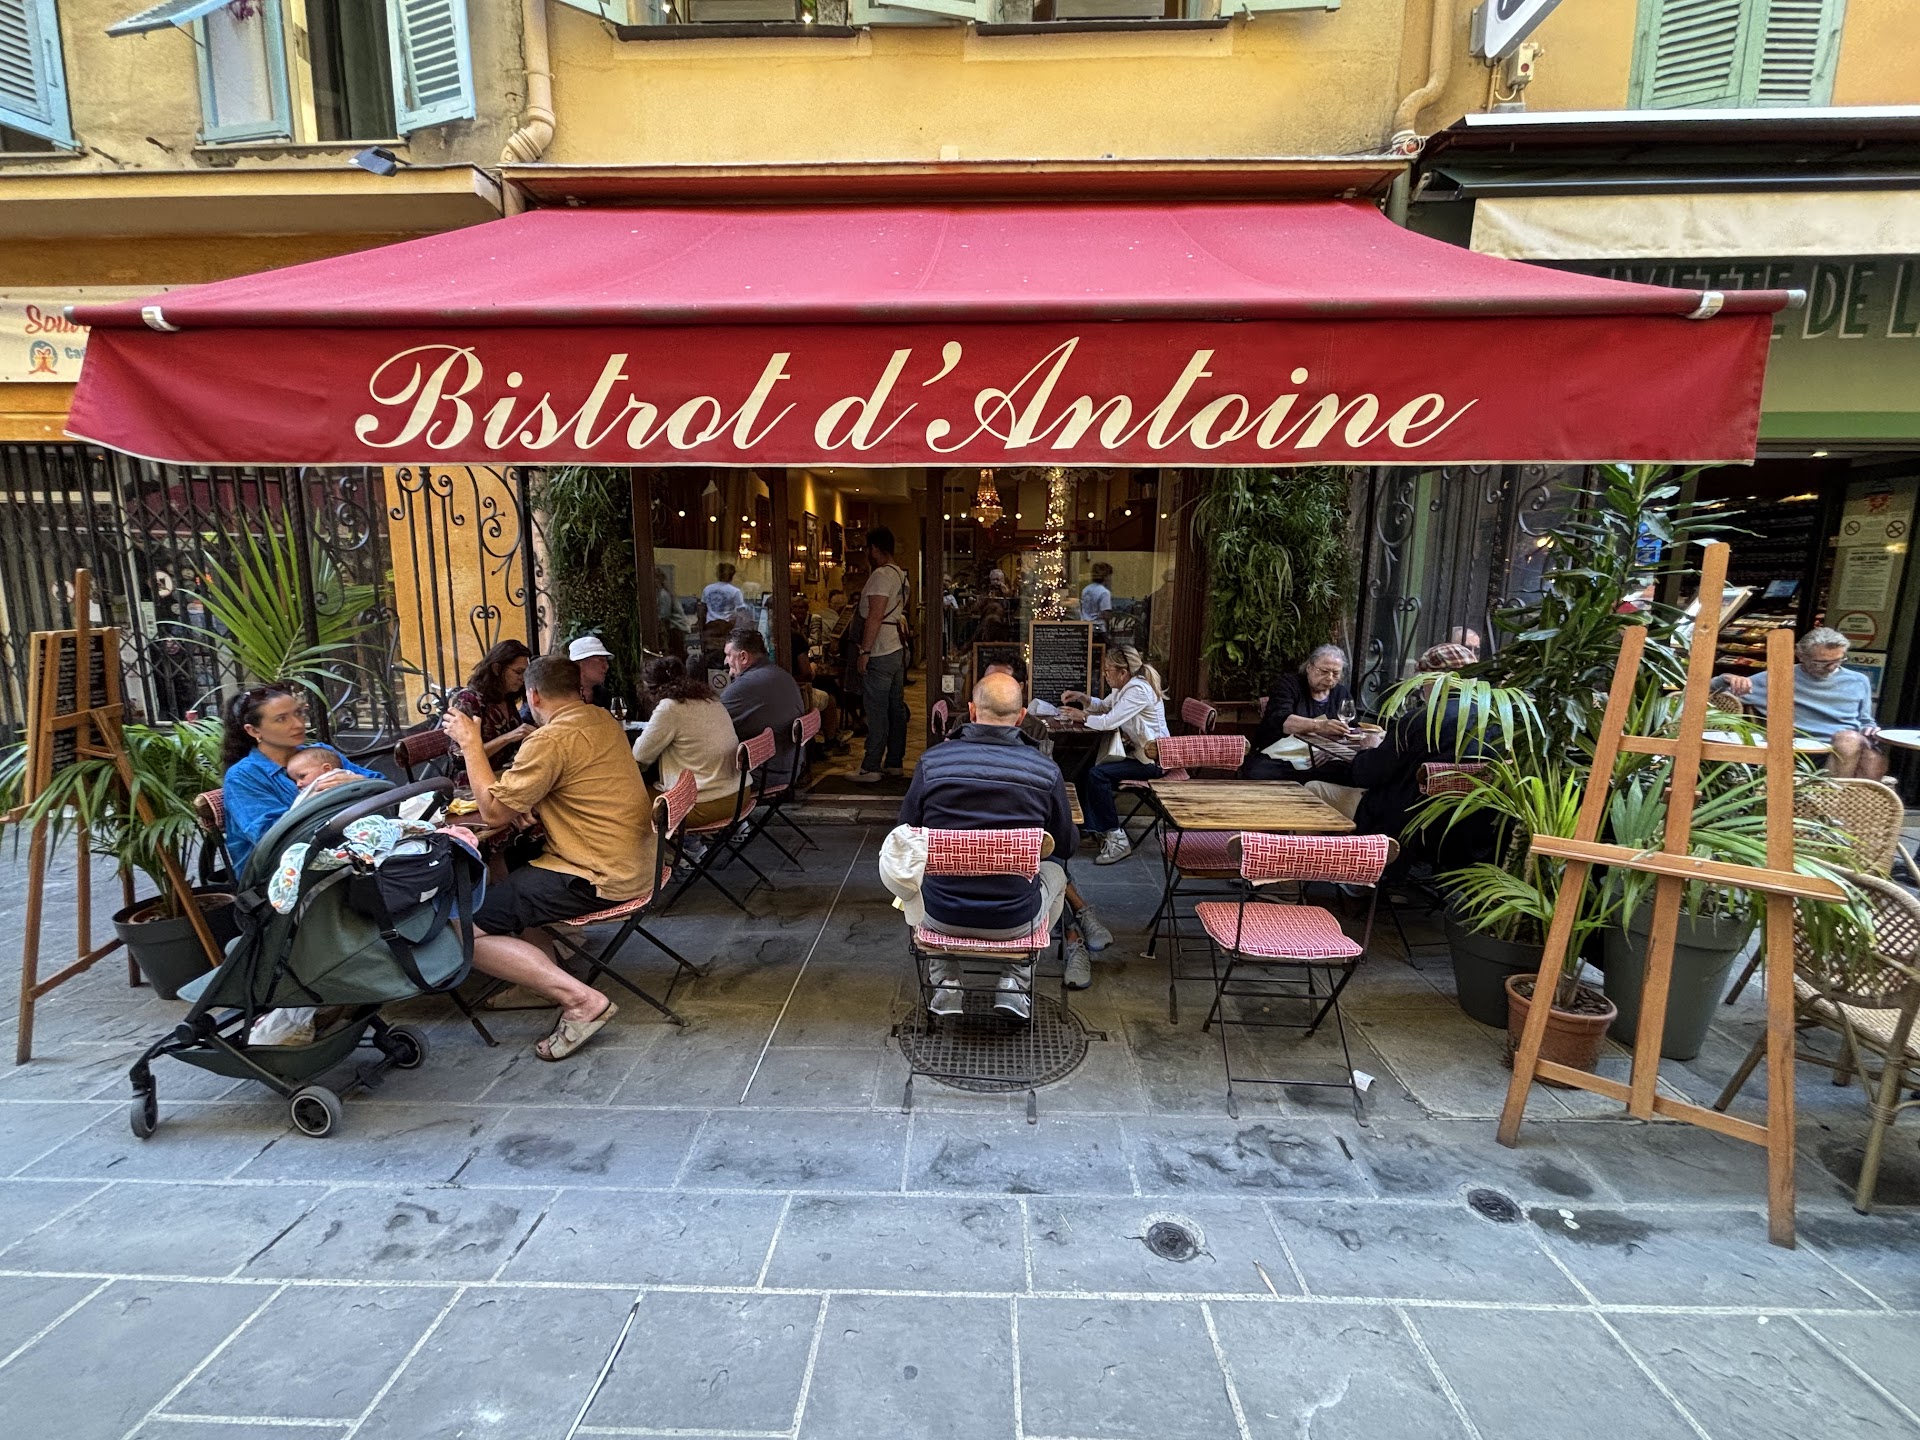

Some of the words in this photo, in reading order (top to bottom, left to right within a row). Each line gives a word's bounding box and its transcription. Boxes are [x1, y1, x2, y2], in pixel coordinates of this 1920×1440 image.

[1802, 262, 1877, 339] DE
[1886, 261, 1920, 338] L
[355, 344, 797, 450] Bistrot
[815, 336, 1479, 453] d'Antoine
